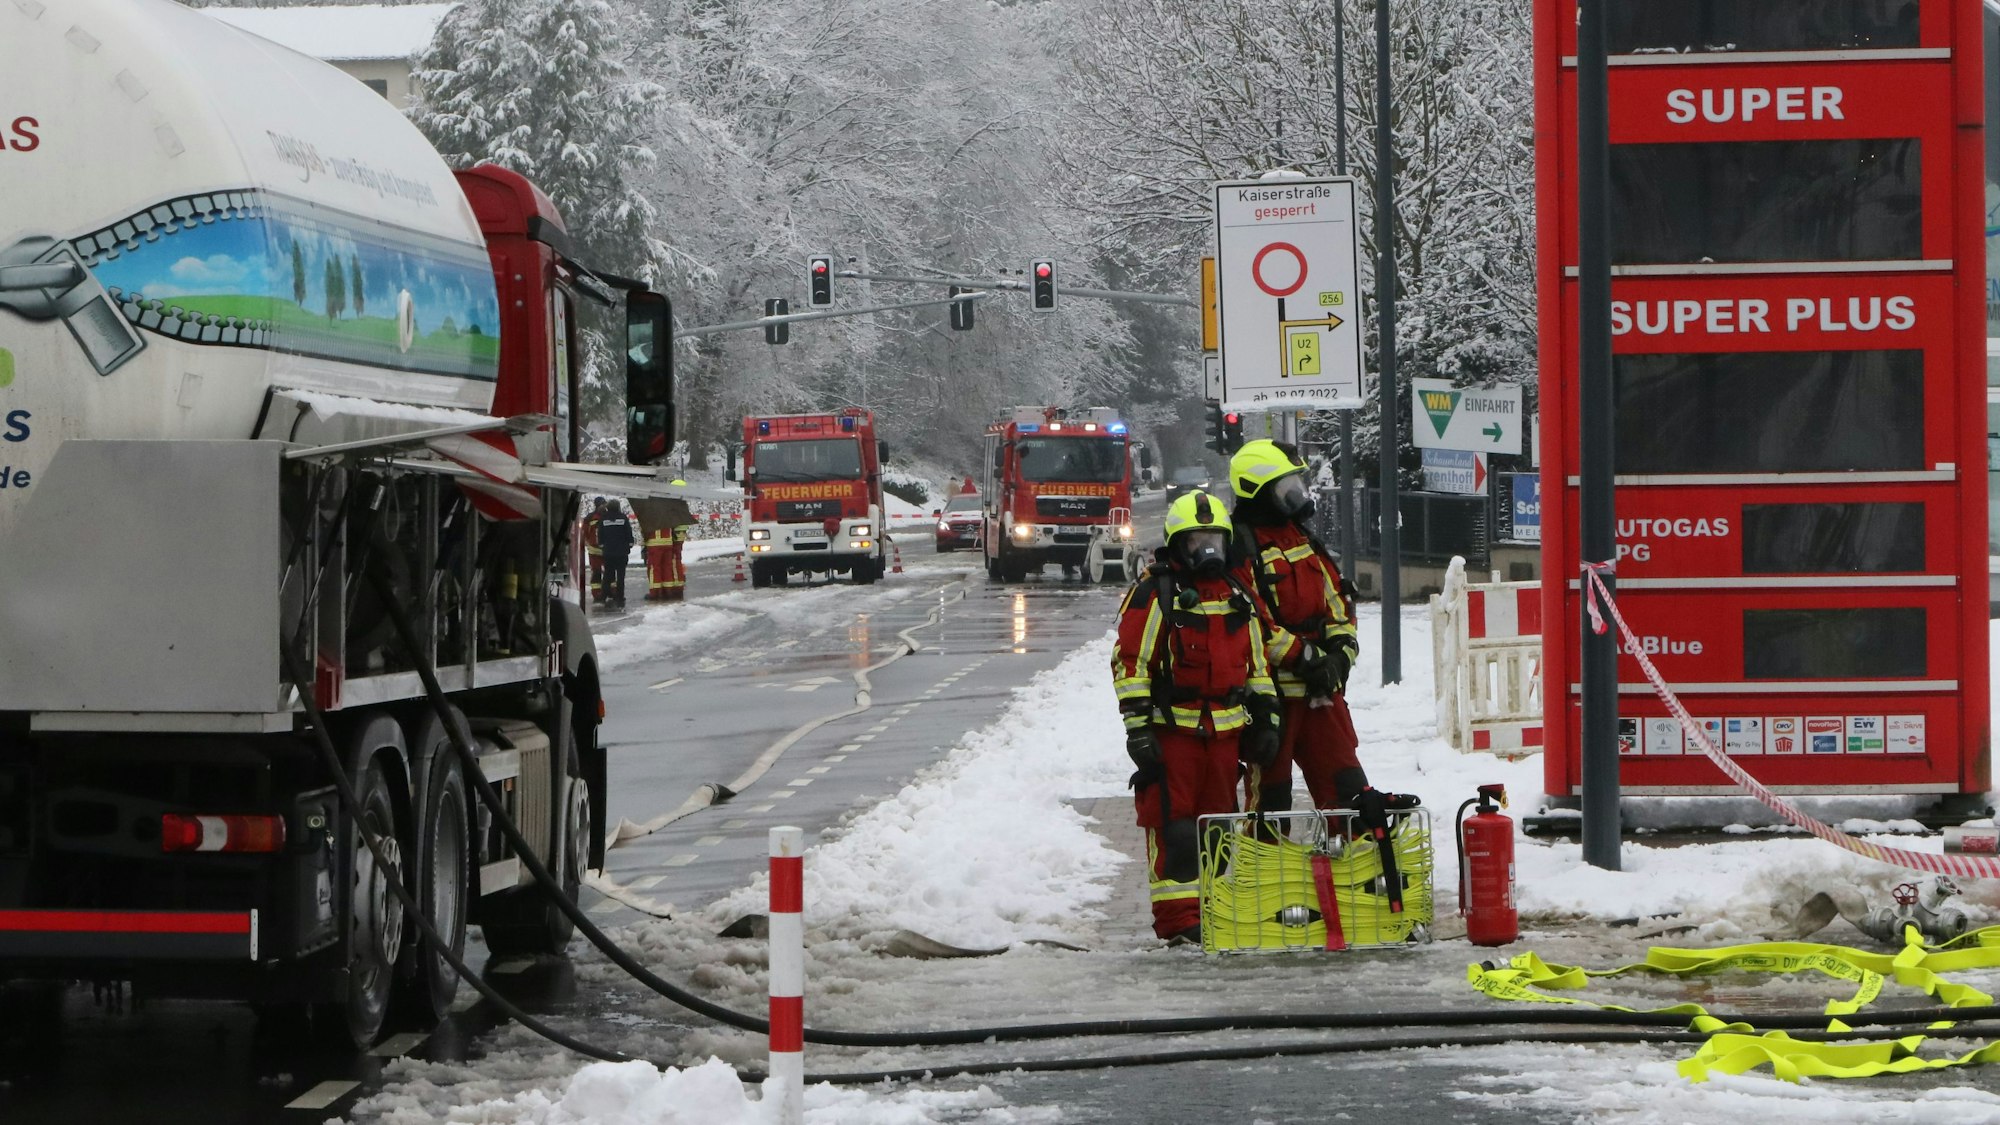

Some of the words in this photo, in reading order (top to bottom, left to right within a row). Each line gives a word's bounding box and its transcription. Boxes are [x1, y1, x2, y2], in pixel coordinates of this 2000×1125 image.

[1666, 86, 1844, 124] SUPER
[0, 116, 40, 152] S
[1239, 186, 1330, 202] Kaiserstraße
[1255, 203, 1315, 220] gesperrt
[1322, 295, 1339, 304] 256
[1611, 299, 1771, 336] SUPER
[1787, 296, 1916, 332] PLUS
[1298, 339, 1312, 349] U2
[1426, 392, 1452, 411] WM
[1465, 398, 1516, 414] EINFAHRT
[764, 485, 852, 499] FEUERWEHR
[1031, 485, 1116, 496] FEUERWEHR
[1614, 518, 1730, 538] UTOGAS
